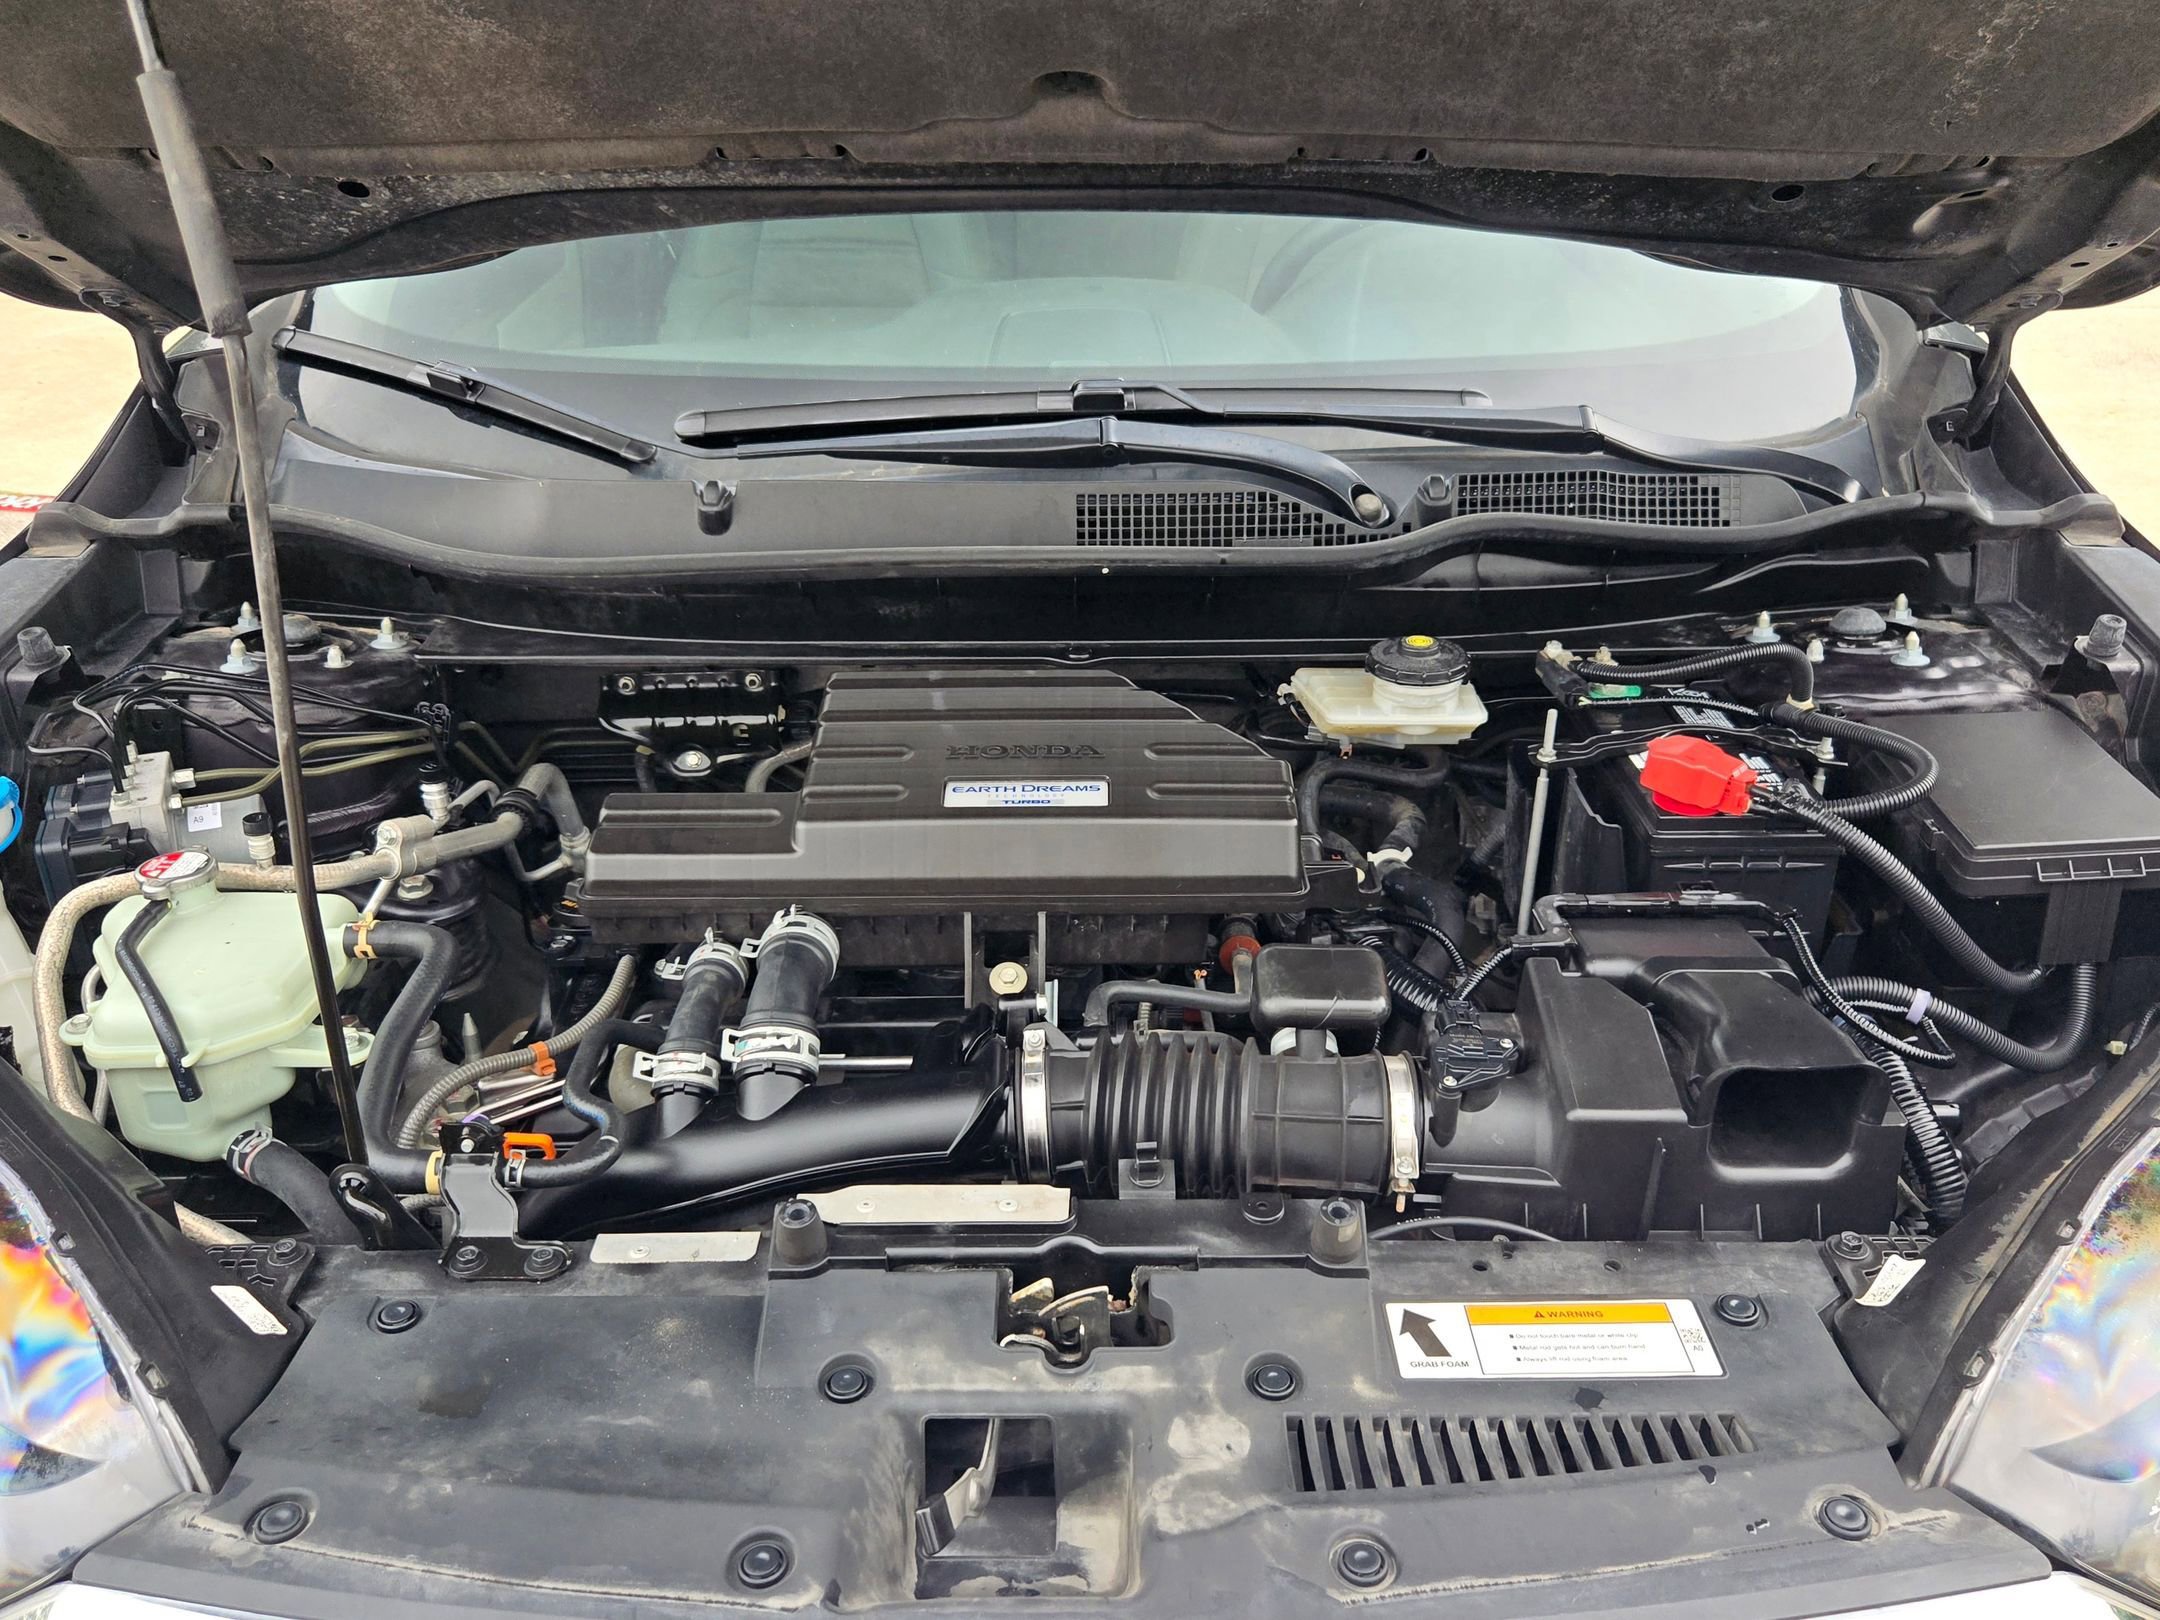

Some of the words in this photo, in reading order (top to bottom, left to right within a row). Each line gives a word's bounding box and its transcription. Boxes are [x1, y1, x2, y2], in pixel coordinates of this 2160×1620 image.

[945, 744, 1106, 759] HONDA
[952, 785, 1016, 793] EARTH
[1021, 784, 1101, 793] DREAMS
[193, 815, 204, 824] A9
[1546, 1310, 1604, 1318] WARNING
[1410, 1360, 1439, 1368] GRAB
[1440, 1360, 1470, 1368] FOAM
